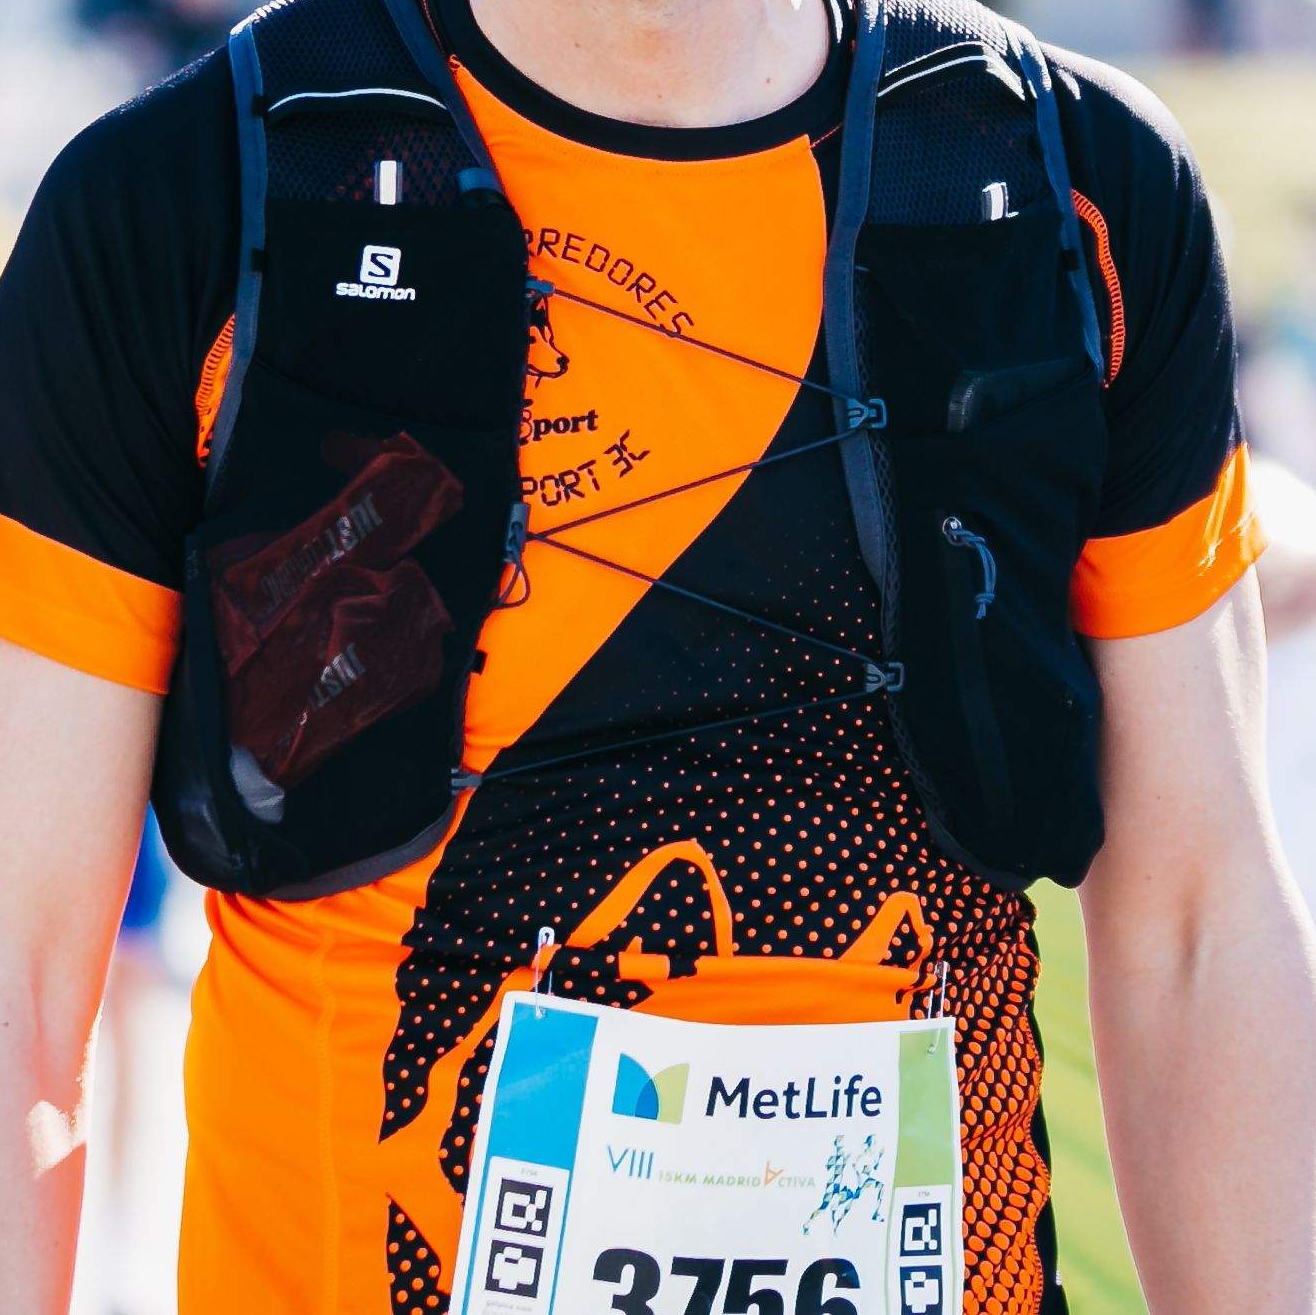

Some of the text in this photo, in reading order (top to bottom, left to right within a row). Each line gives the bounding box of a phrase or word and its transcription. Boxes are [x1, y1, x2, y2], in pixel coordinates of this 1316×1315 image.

[705, 1074, 883, 1120] MetLife
[606, 1142, 655, 1180] VIII
[658, 1169, 698, 1185] 15KM
[702, 1172, 761, 1188] MADRID
[592, 1247, 861, 1315] 3756
